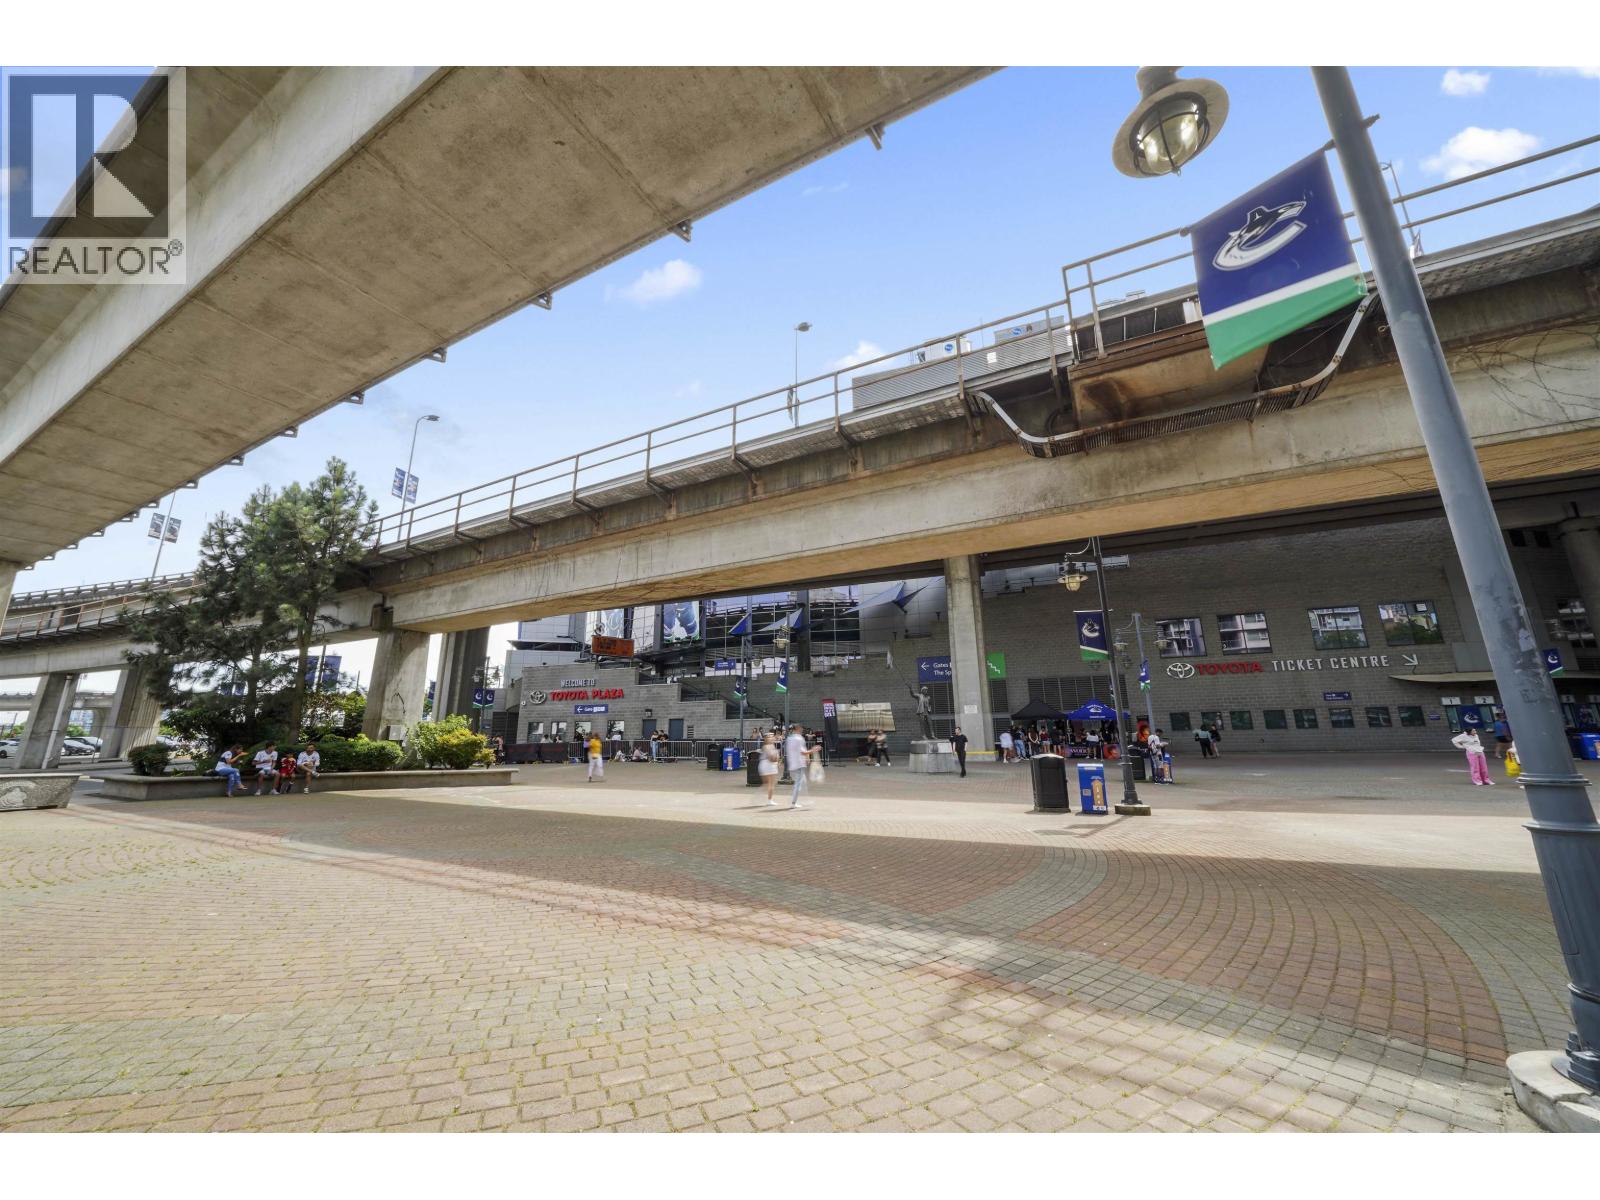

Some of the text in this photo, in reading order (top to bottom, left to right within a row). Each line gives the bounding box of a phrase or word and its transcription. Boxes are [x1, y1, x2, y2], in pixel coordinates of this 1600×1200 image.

[1194, 655, 1390, 676] TOYOTA TICKET CENTRE
[560, 678, 596, 688] WELCOME TO
[550, 687, 624, 701] TOYOTA PLAZA
